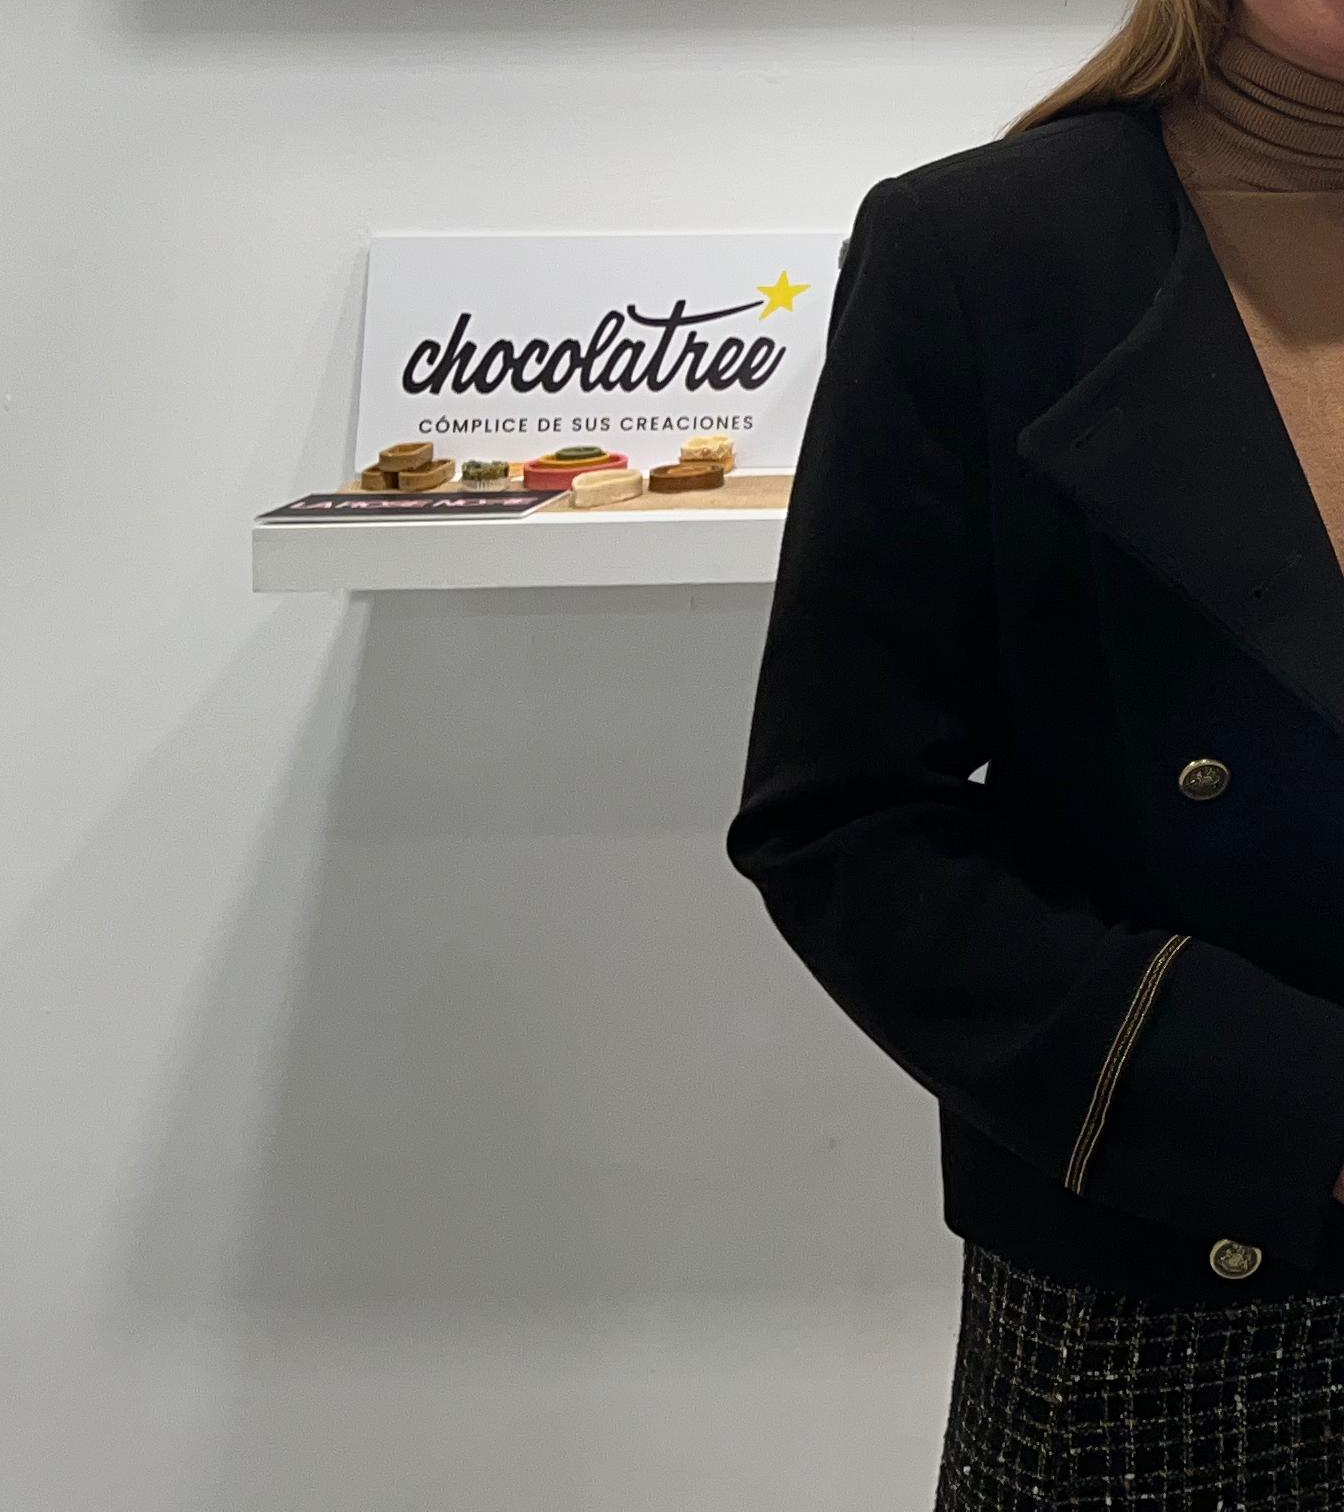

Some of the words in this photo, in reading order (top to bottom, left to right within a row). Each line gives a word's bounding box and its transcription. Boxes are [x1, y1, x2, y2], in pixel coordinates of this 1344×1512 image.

[402, 298, 787, 395] chocolatree
[418, 412, 529, 435] CÓMPLICE
[537, 416, 562, 434] DE
[571, 415, 611, 433] SUS
[619, 414, 754, 433] CREACIONES
